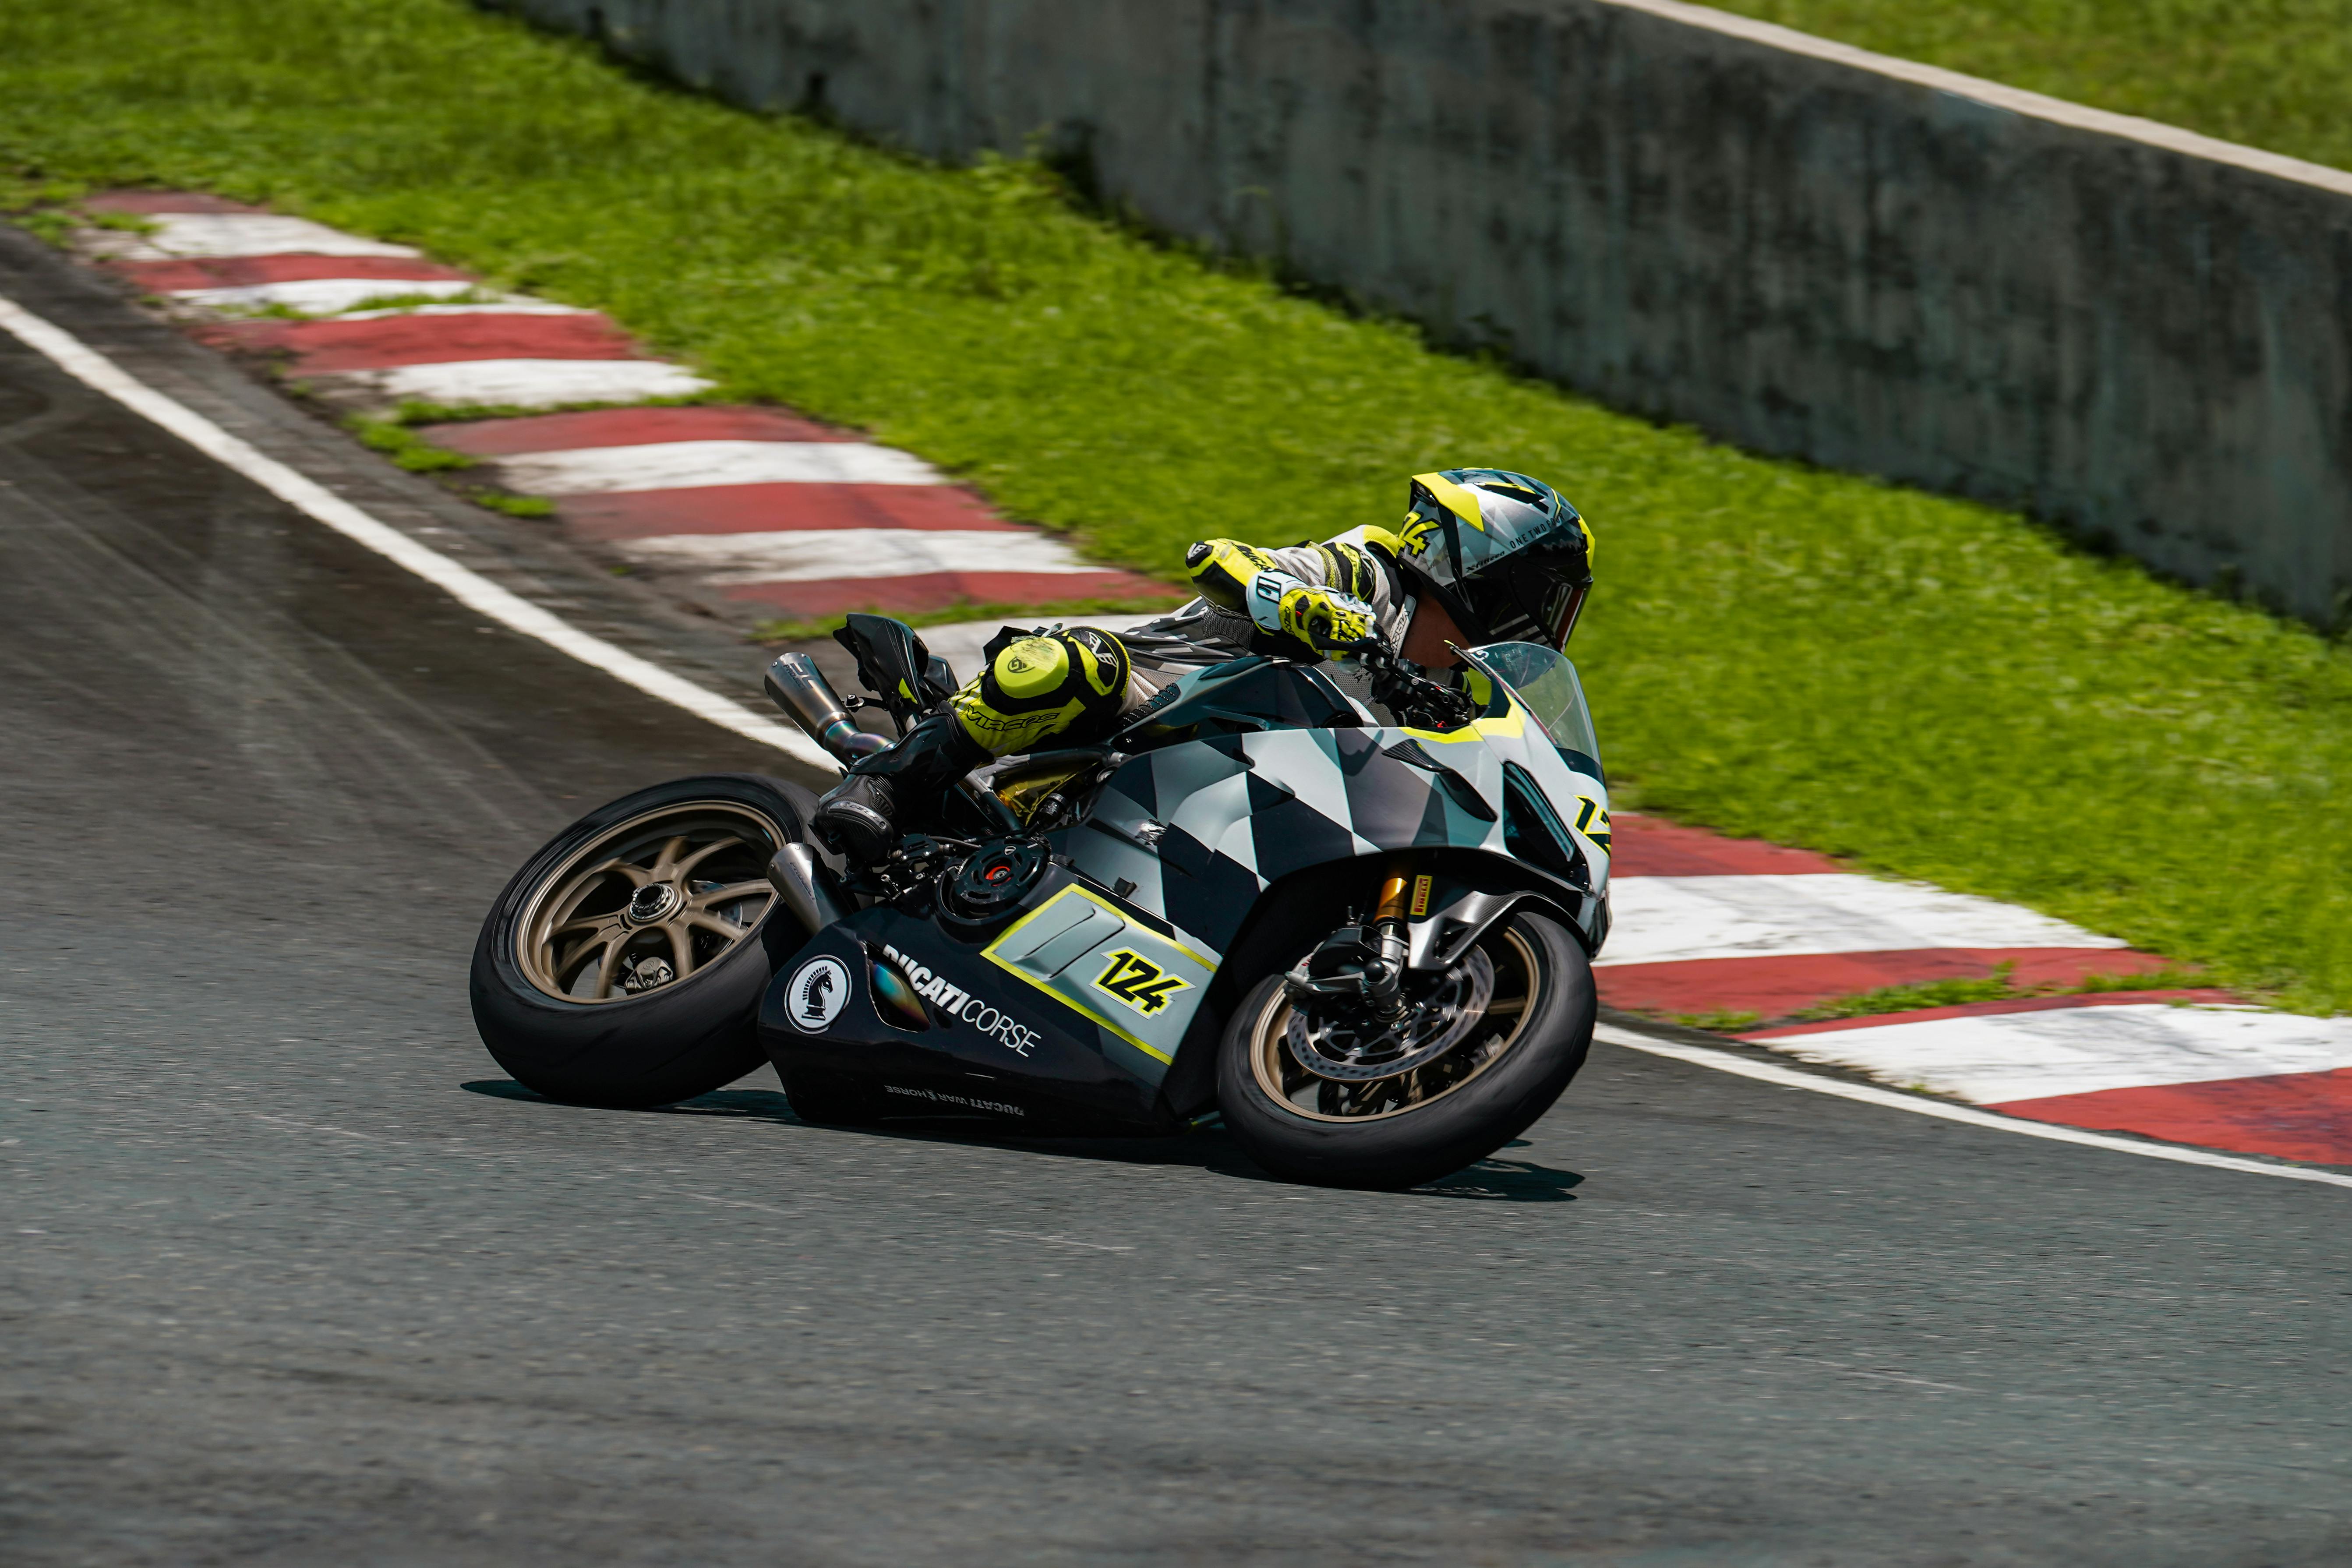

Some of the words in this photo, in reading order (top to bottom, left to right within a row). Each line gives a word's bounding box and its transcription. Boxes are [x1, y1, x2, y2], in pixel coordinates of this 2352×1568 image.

[1510, 536, 1528, 549] ONE
[1531, 524, 1547, 539] TWO
[1546, 513, 1565, 531] FOUR
[783, 664, 806, 691] PROJECT
[1095, 949, 1190, 1015] 124
[884, 1084, 927, 1099] HORSE
[936, 1092, 968, 1105] WAR
